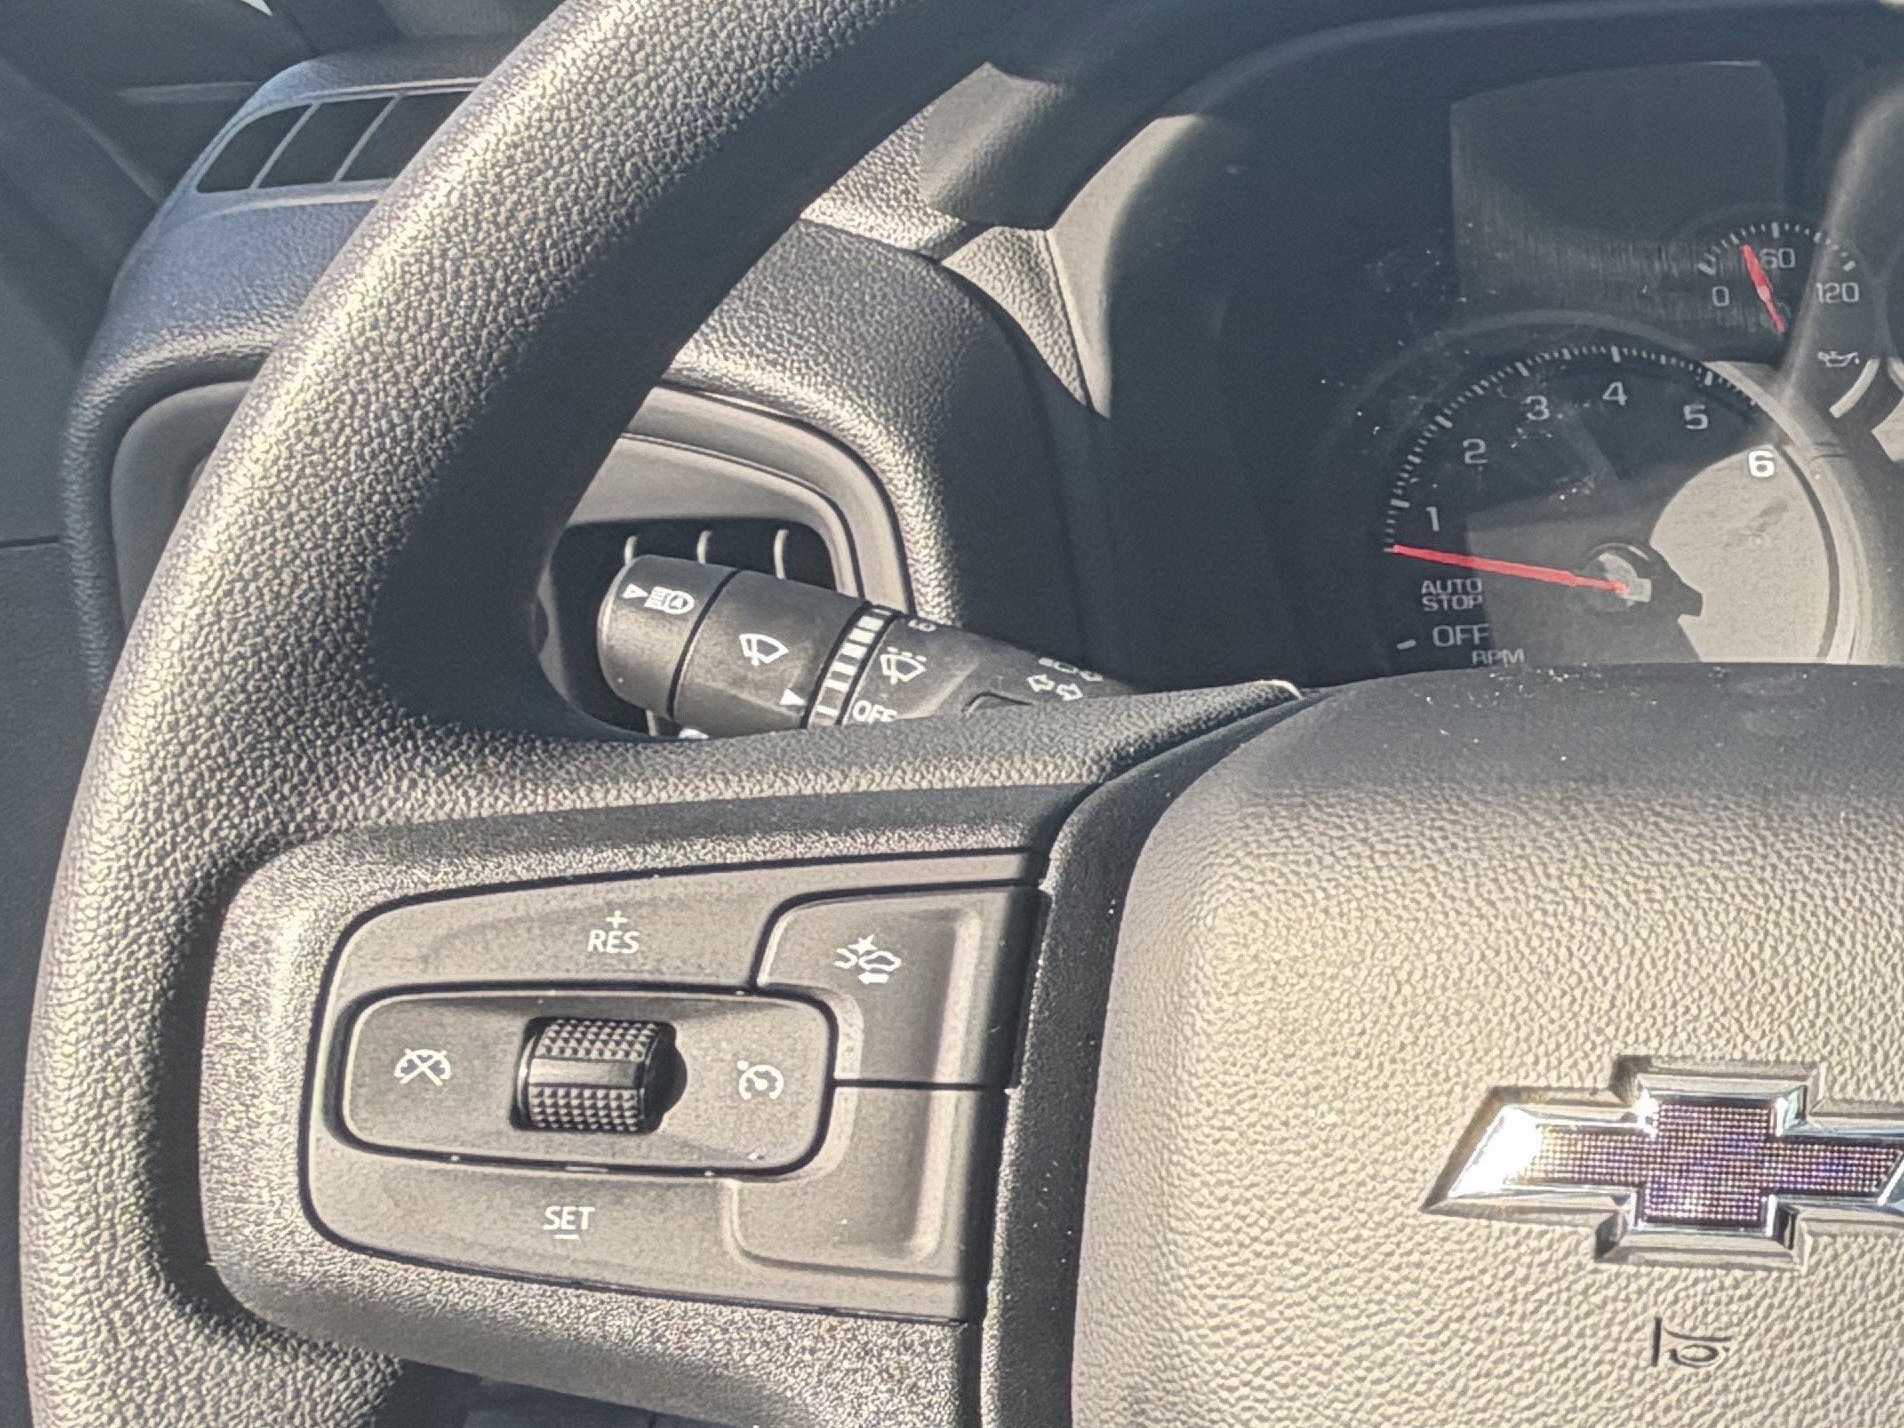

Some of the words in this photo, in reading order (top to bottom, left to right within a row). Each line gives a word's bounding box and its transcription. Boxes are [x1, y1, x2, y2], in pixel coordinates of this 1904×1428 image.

[1712, 286, 1730, 308] 0
[1816, 282, 1860, 303] 120
[1602, 381, 1628, 406] 4
[1526, 395, 1550, 421] 3
[1683, 404, 1709, 431] 5
[1462, 438, 1488, 465] 2
[1748, 450, 1775, 478] 6
[1426, 506, 1440, 532] 1
[1421, 578, 1482, 595] AUTO
[1422, 594, 1483, 611] STOP
[1432, 623, 1490, 647] OFF
[1471, 648, 1525, 667] RPM
[587, 930, 640, 955] RES
[543, 1204, 595, 1232] SET
